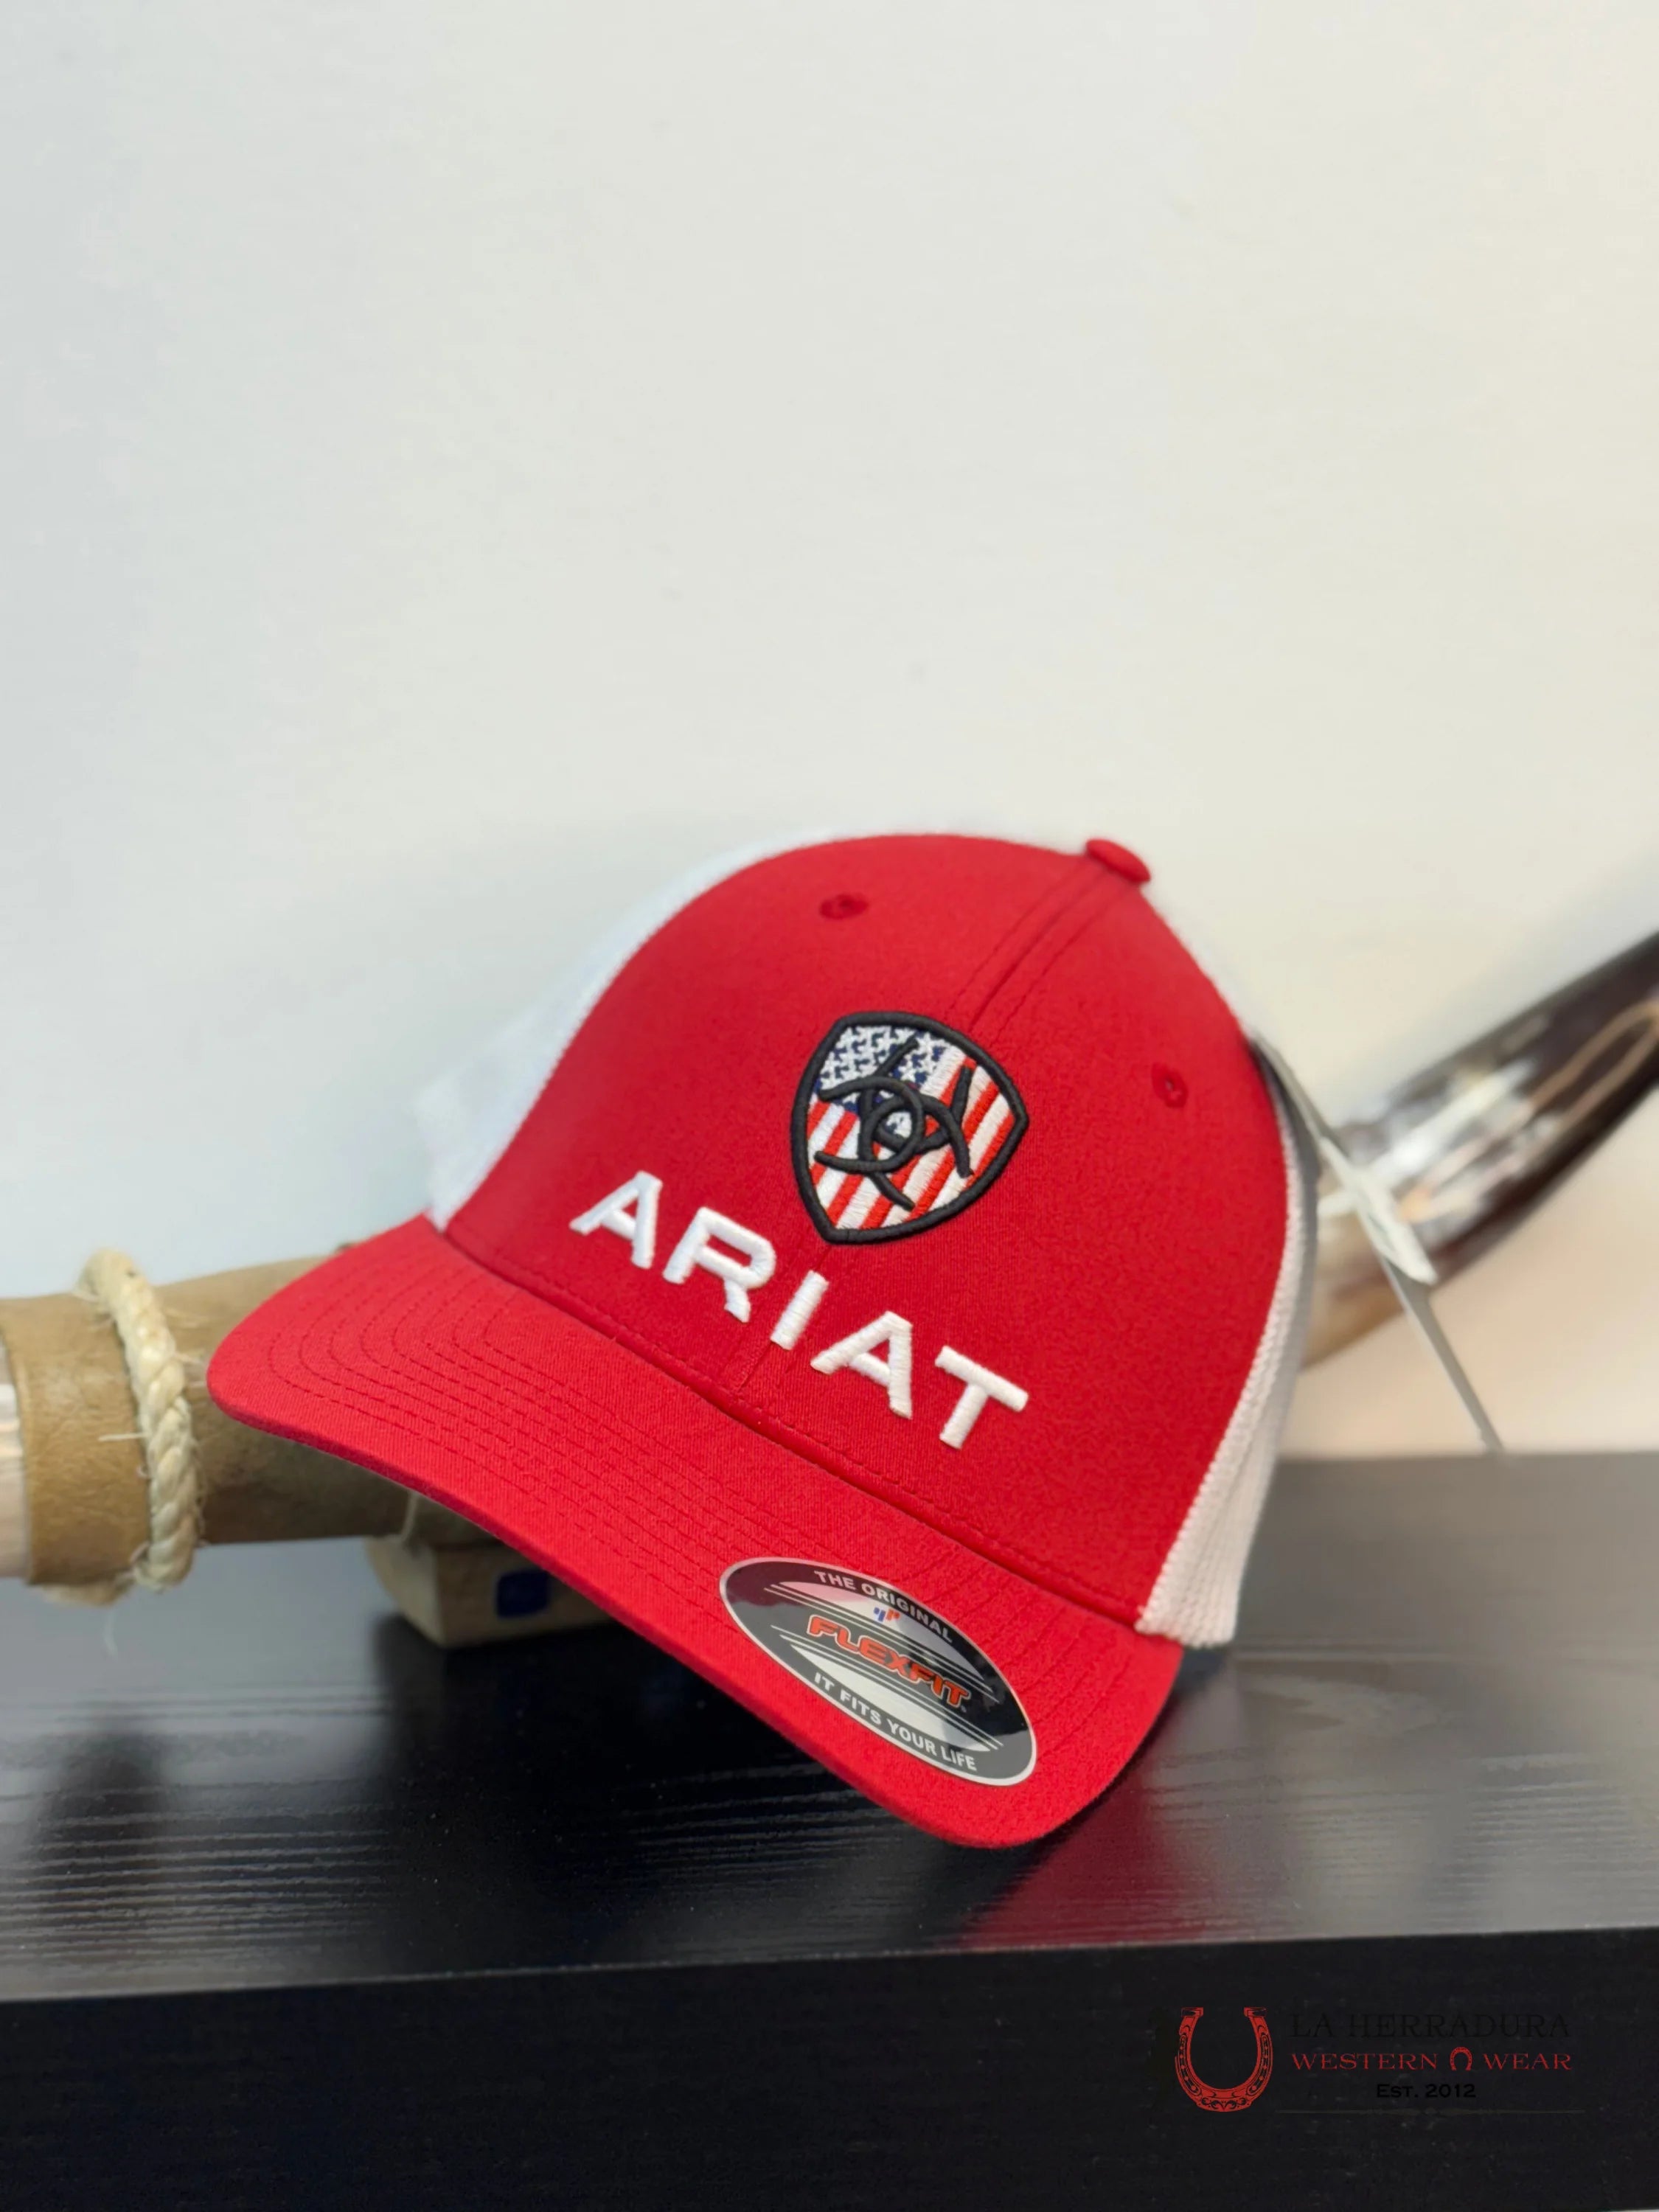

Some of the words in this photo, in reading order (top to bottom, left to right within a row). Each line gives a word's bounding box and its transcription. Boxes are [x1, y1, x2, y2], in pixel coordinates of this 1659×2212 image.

[569, 1170, 1029, 1450] ARIAT
[813, 1570, 856, 1591] THE
[861, 1584, 953, 1643] ORIGINAL
[807, 1615, 971, 1708] FLEXFIT
[814, 1672, 834, 1691] IT
[841, 1691, 883, 1726] FITS
[887, 1719, 937, 1757] YOUR
[942, 1747, 977, 1771] LIFE
